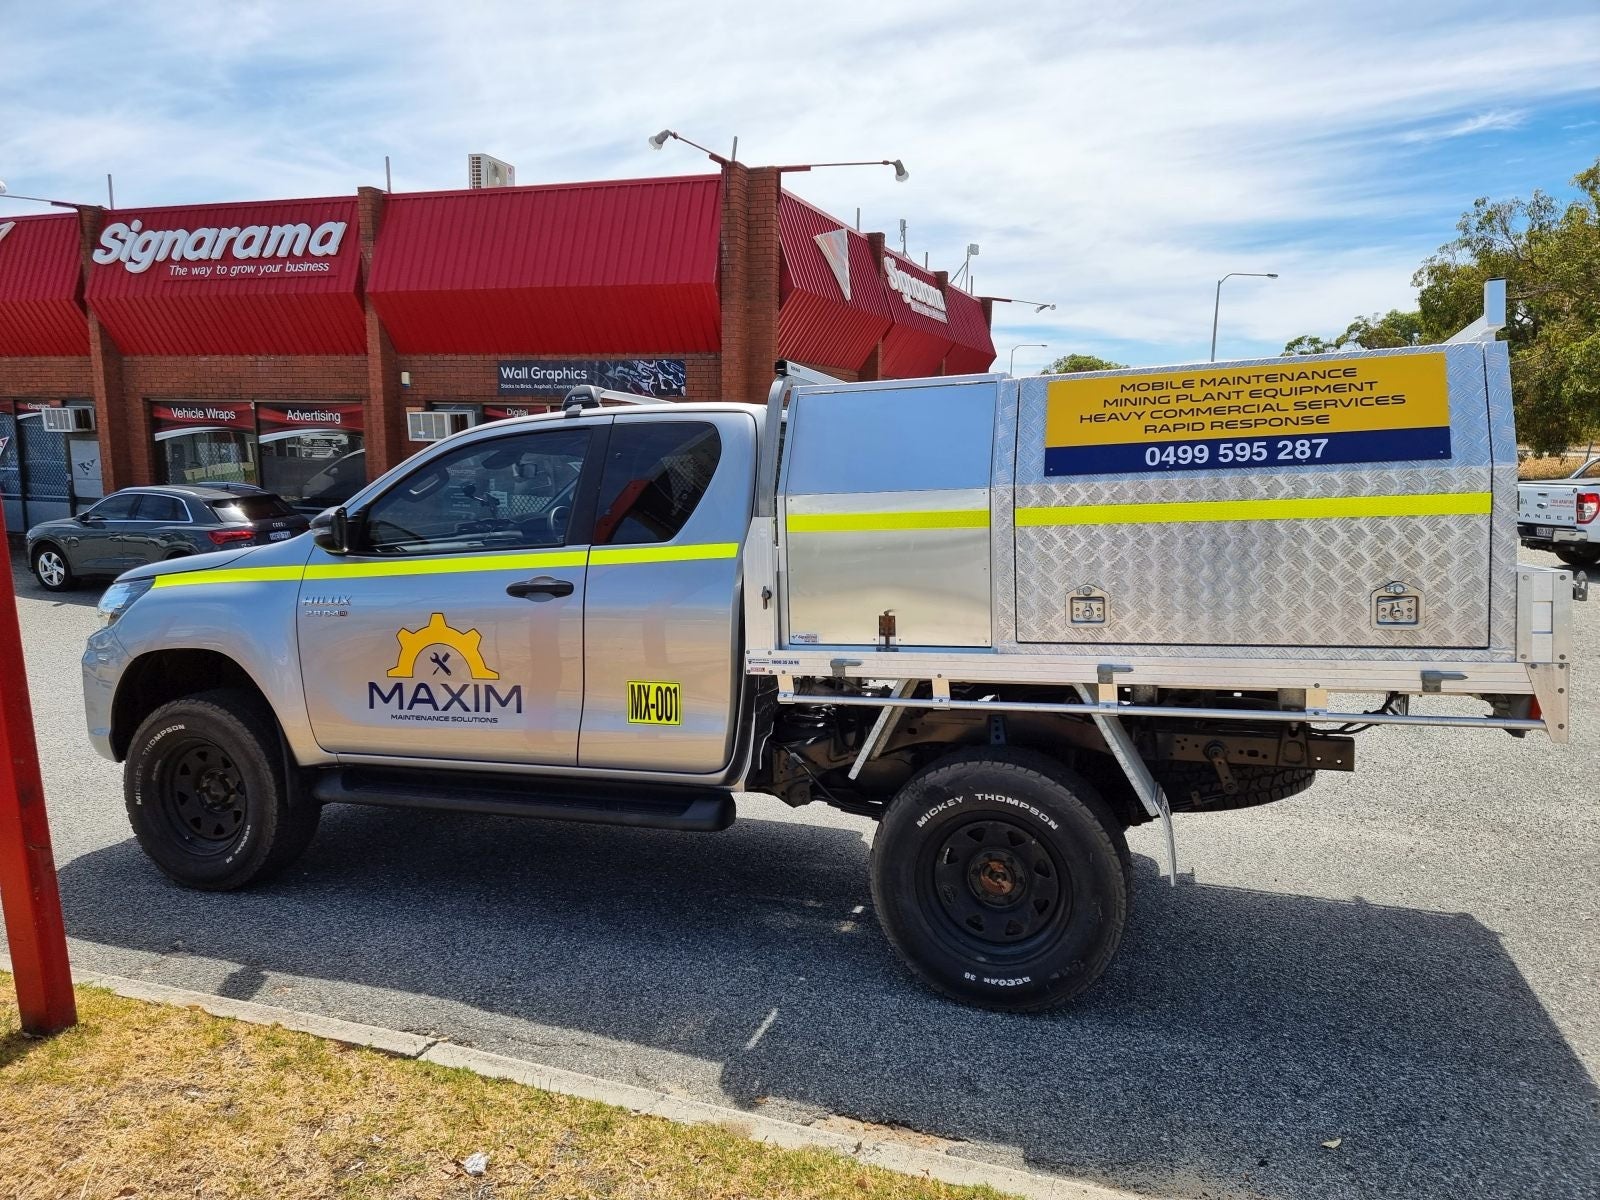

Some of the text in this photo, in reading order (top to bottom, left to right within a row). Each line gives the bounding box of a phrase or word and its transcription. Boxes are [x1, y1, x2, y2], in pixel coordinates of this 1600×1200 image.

[93, 219, 347, 273] Signarama
[169, 261, 330, 278] The way to grow your business
[500, 366, 588, 382] Wall Graphics
[1120, 368, 1357, 393] MOBILE MAINTENANCE
[1103, 381, 1379, 408] MINING PLANT EQUIPMENT
[171, 407, 236, 421] Vehicle Wraps
[286, 410, 341, 424] Advertising
[506, 408, 529, 417] Digital
[1079, 394, 1406, 424] HEAVY COMMERCIAL SERVICES
[1144, 414, 1330, 434] RAPID RESPONSE
[1145, 438, 1329, 466] 0499 595 287
[302, 595, 352, 606] HILUX
[367, 681, 522, 714] MAXIM
[630, 684, 679, 722] MX-001
[390, 713, 499, 724] MAINTENANCE SOLUTIONS
[142, 723, 186, 756] THOMPSON
[916, 792, 1059, 831] MICKEY THOMPSON
